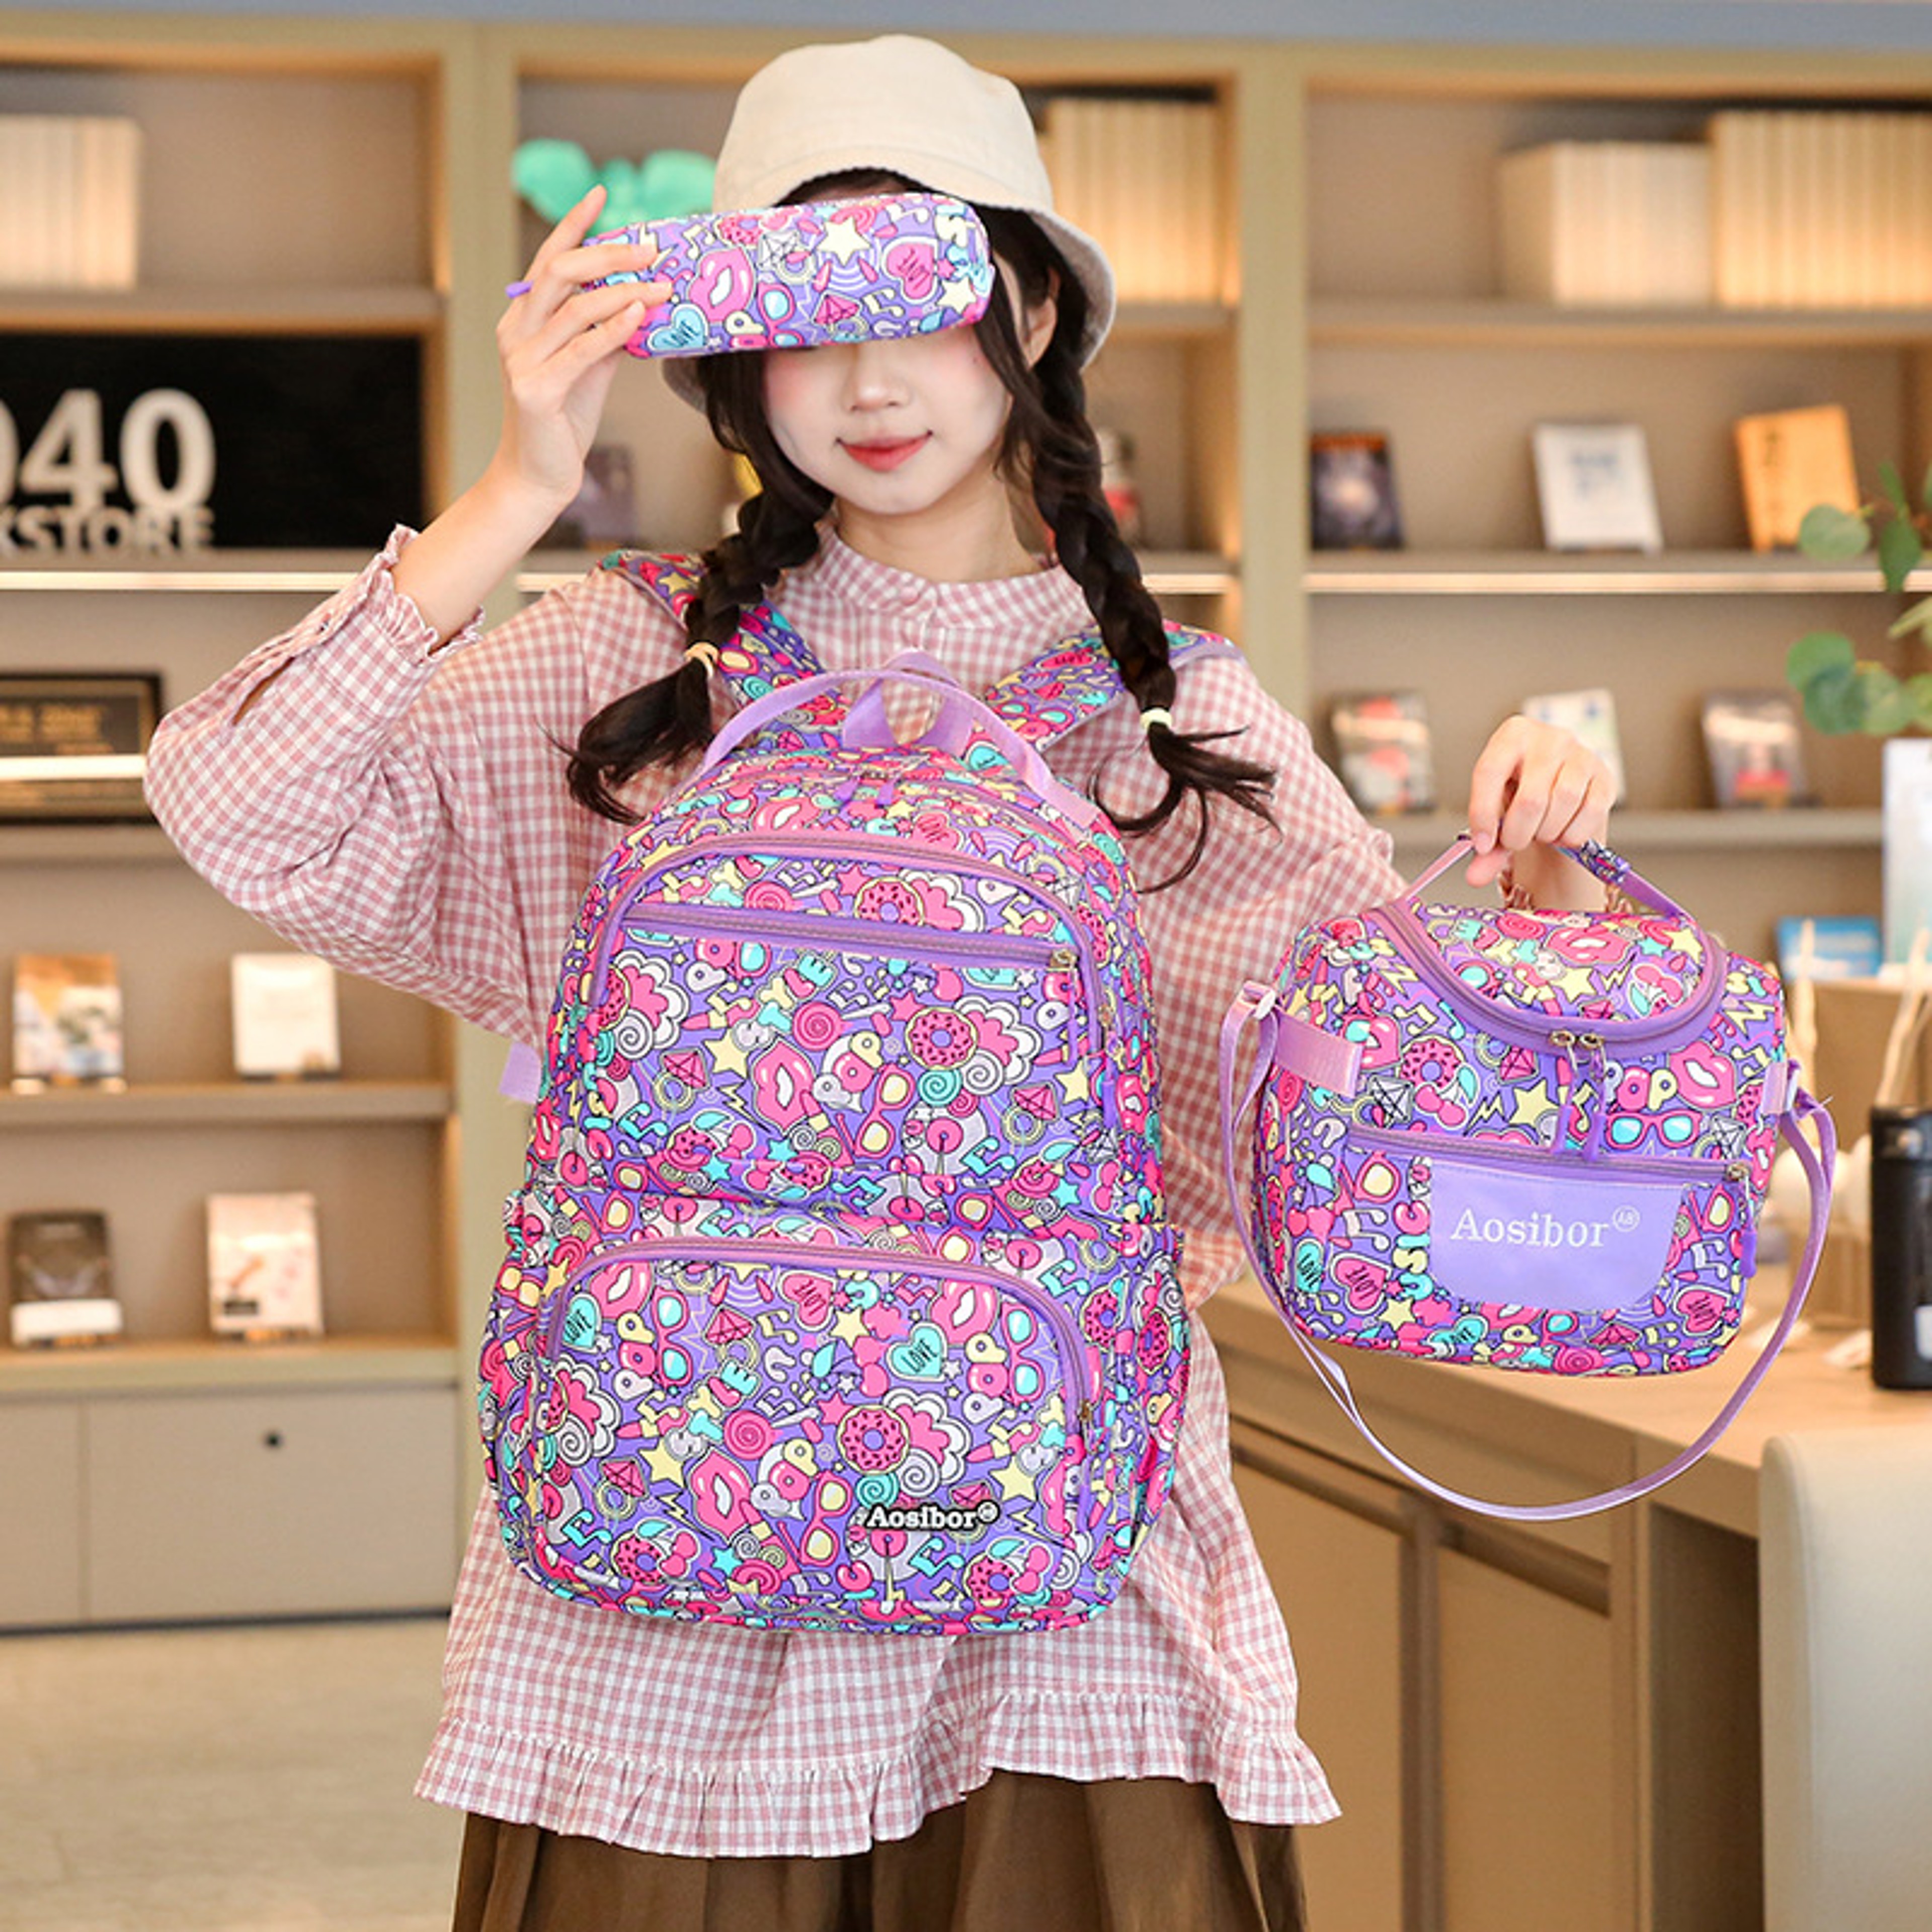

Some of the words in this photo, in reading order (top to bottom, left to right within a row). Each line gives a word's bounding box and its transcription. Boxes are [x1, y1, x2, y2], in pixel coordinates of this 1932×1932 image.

[0, 386, 216, 509] 40
[1450, 1208, 1610, 1249] Aosibor
[900, 1337, 940, 1374] LOVE
[866, 1505, 977, 1528] Aosibor
